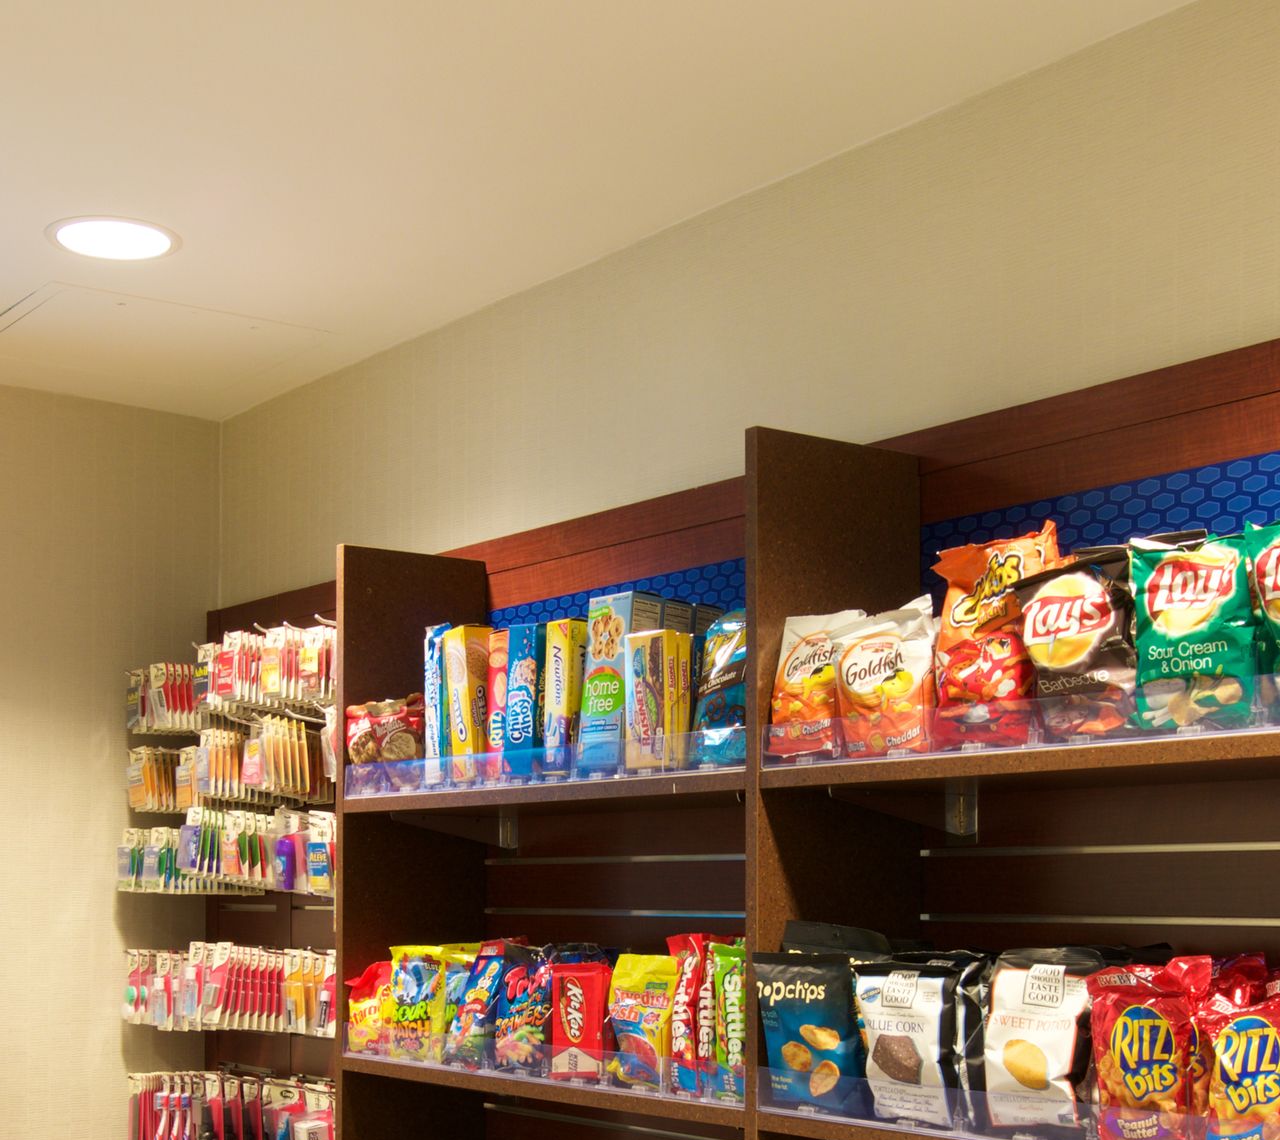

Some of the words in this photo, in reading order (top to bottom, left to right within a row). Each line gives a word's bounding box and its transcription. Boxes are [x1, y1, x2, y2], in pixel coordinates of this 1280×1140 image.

[1148, 645, 1174, 662] Sour
[1178, 639, 1228, 656] Cream
[845, 648, 905, 687] Goldfish
[1162, 660, 1170, 673] &
[1171, 656, 1212, 673] Onion
[552, 645, 563, 706] Newtons
[588, 694, 614, 713] free
[886, 726, 920, 746] Cheddar
[1030, 975, 1064, 985] SHOULD
[1033, 965, 1061, 977] FOOD
[1028, 992, 1059, 1004] GOOD
[1029, 983, 1063, 995] TASTE
[722, 974, 744, 1067] Skittles
[1114, 1016, 1170, 1070] RITZ
[1218, 1027, 1278, 1081] RITZ
[1126, 1061, 1175, 1099] bits
[1117, 1114, 1158, 1131] Peanut
[1122, 1126, 1158, 1139] Butter
